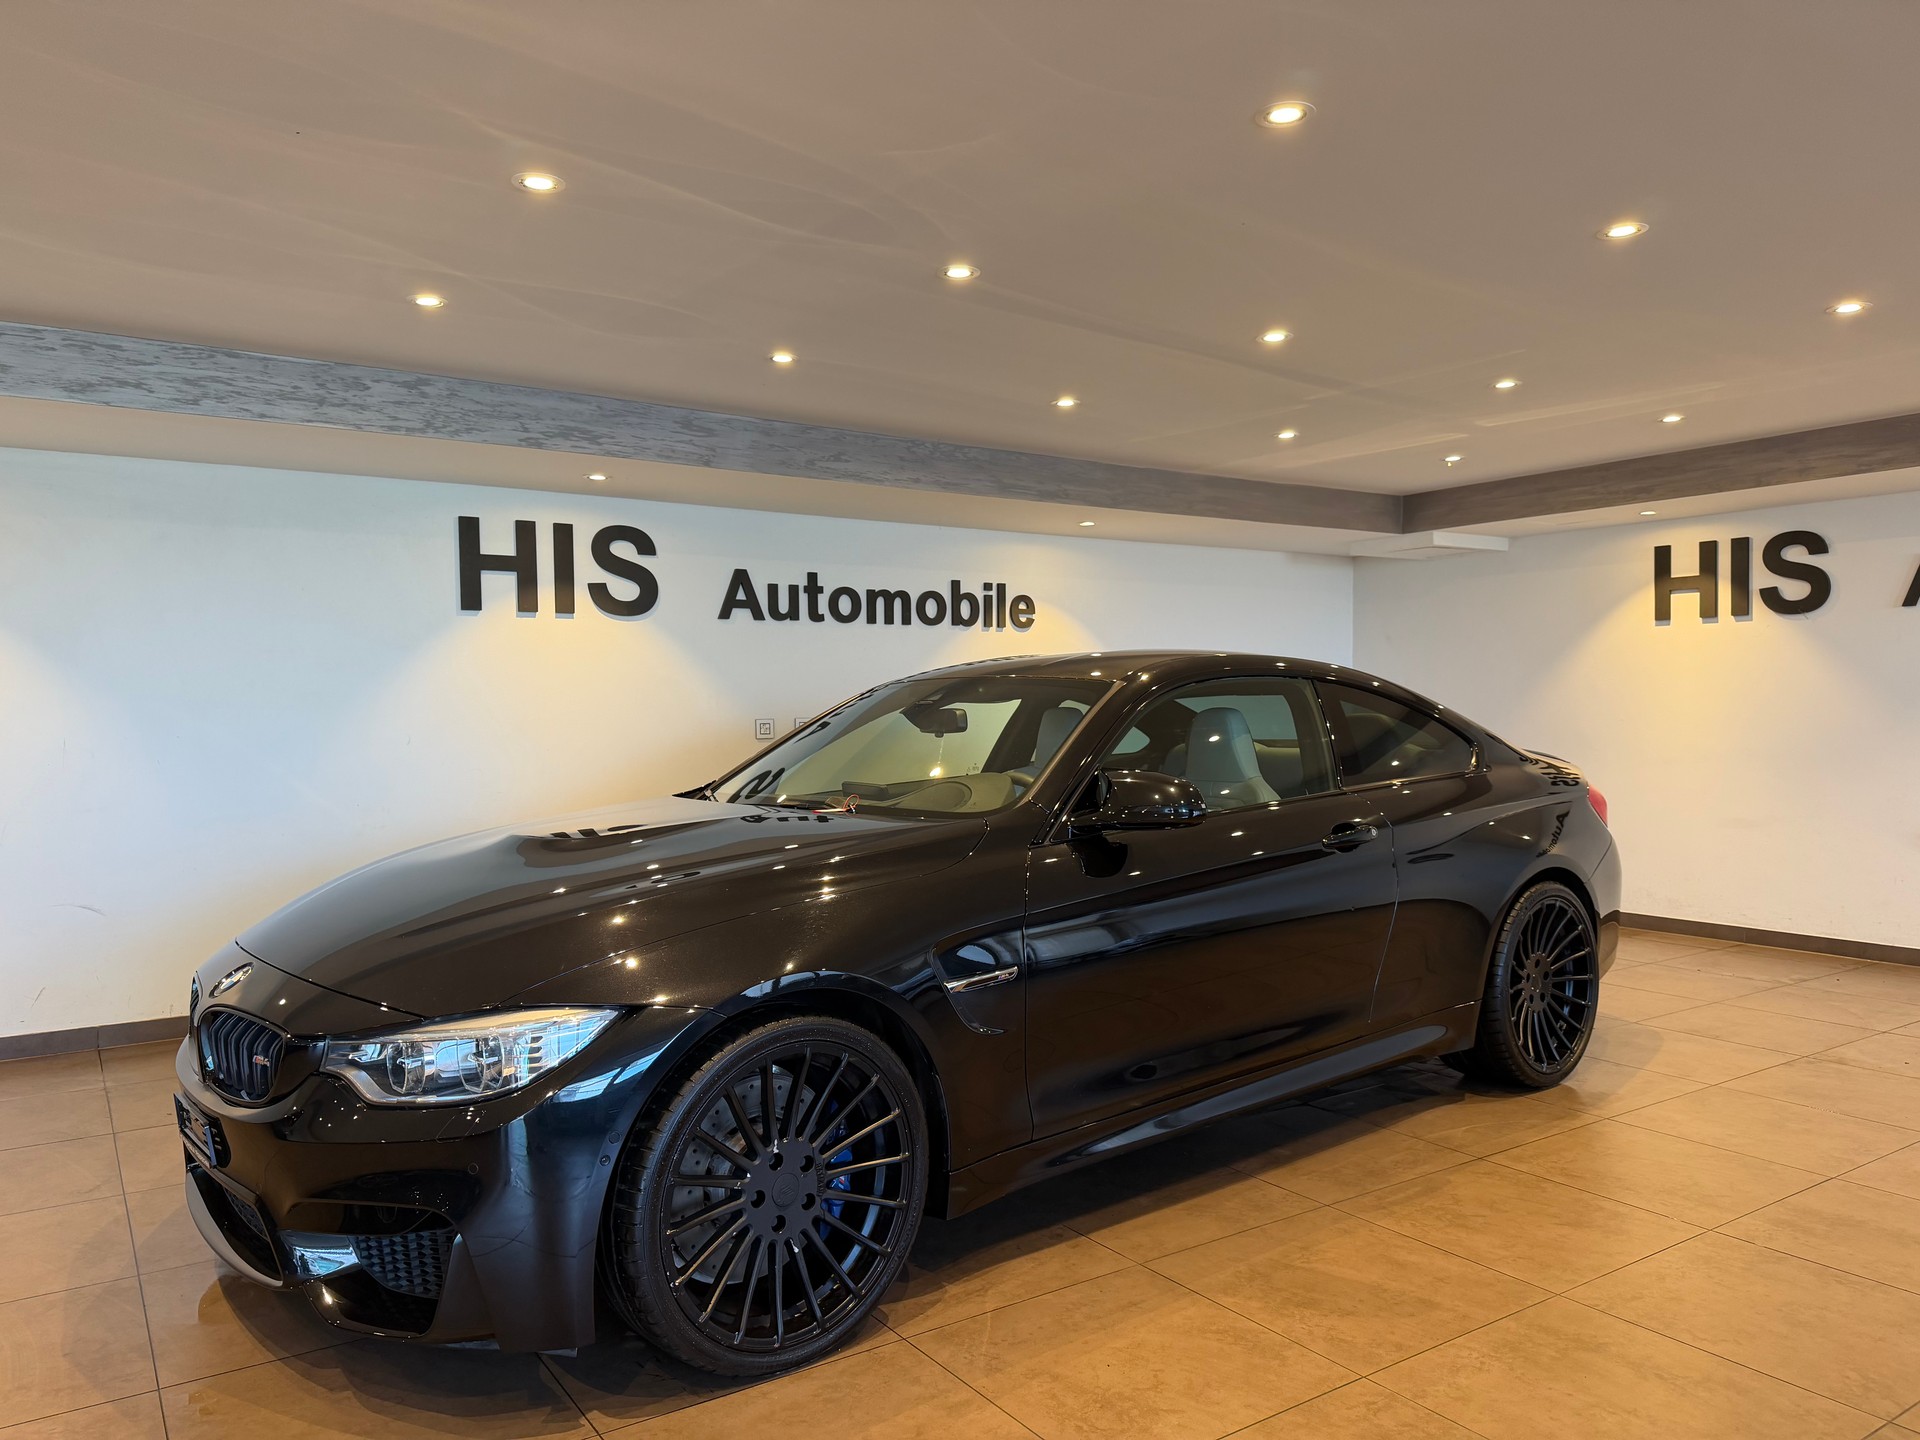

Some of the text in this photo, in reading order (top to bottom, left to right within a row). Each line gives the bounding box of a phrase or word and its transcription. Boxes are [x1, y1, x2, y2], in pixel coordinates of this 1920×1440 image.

[458, 516, 1036, 629] HIS Automobile
[1654, 530, 1832, 621] HIS
